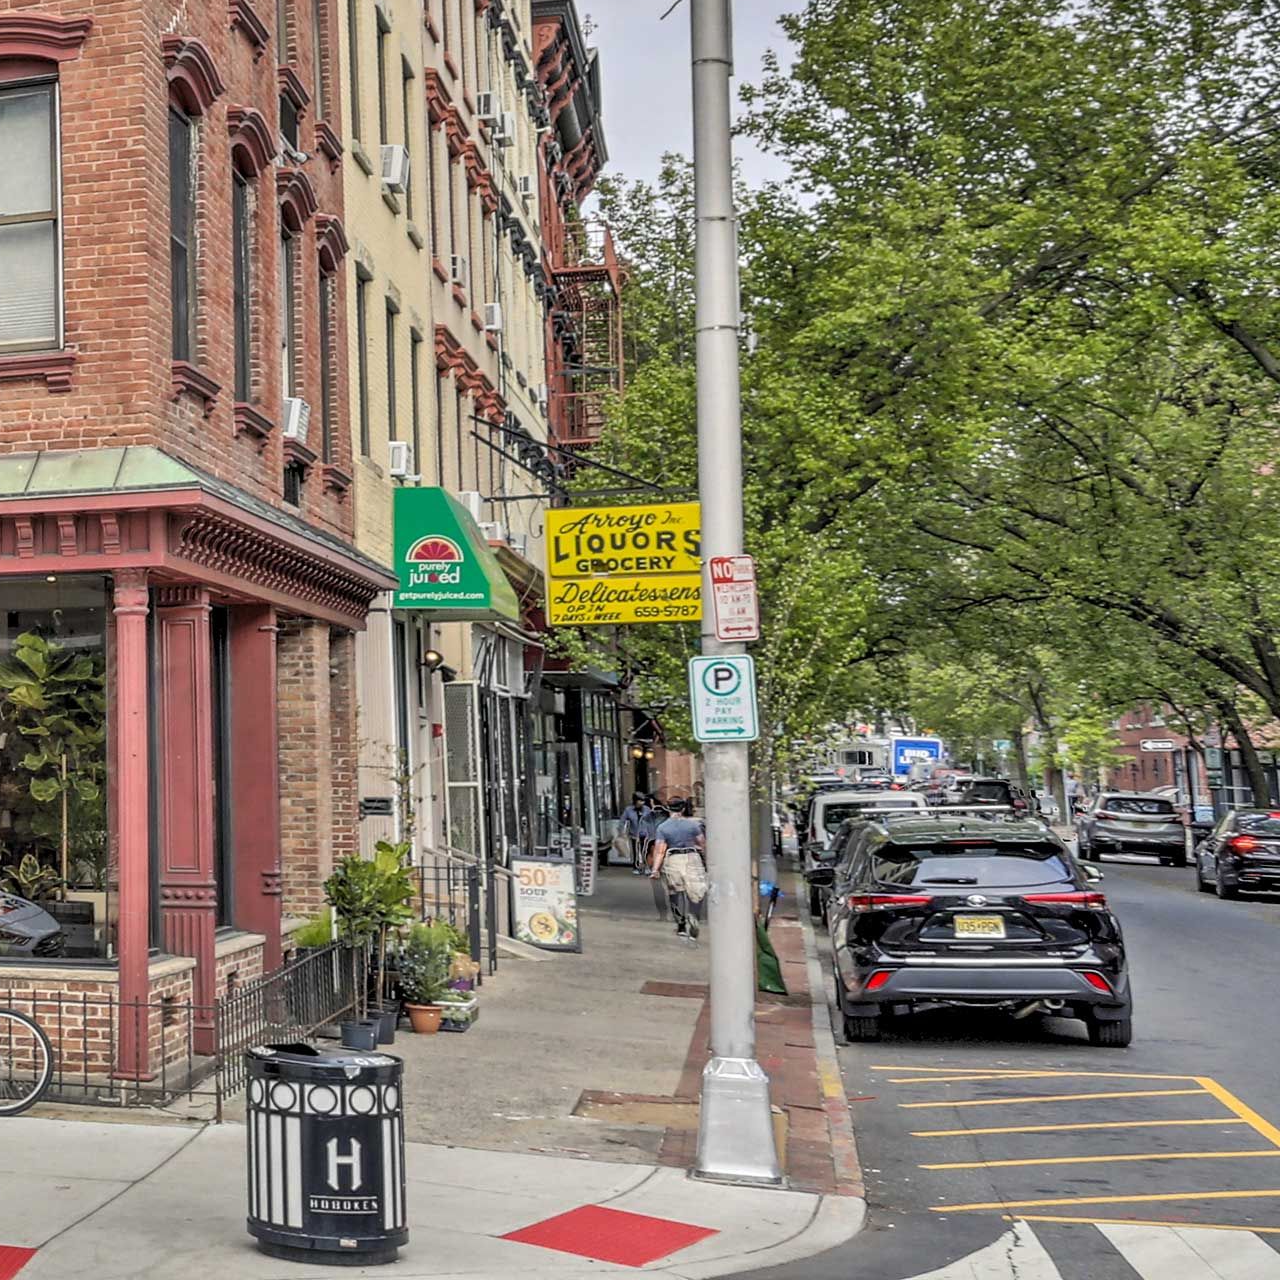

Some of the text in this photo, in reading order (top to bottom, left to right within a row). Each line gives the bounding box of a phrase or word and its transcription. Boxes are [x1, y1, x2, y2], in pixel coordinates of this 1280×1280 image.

[559, 512, 657, 535] Arroyo
[554, 528, 701, 564] LIQUORS
[418, 561, 451, 573] purely
[575, 556, 677, 573] GROCERY
[712, 562, 733, 579] NO
[399, 591, 485, 601] getpurelyjuiced.com
[634, 605, 698, 618] 659-5787
[713, 667, 734, 690] P
[714, 707, 733, 716] PAY
[705, 715, 744, 726] PARKING
[326, 1136, 362, 1191] H
[309, 1198, 378, 1212] HOBOKEN
